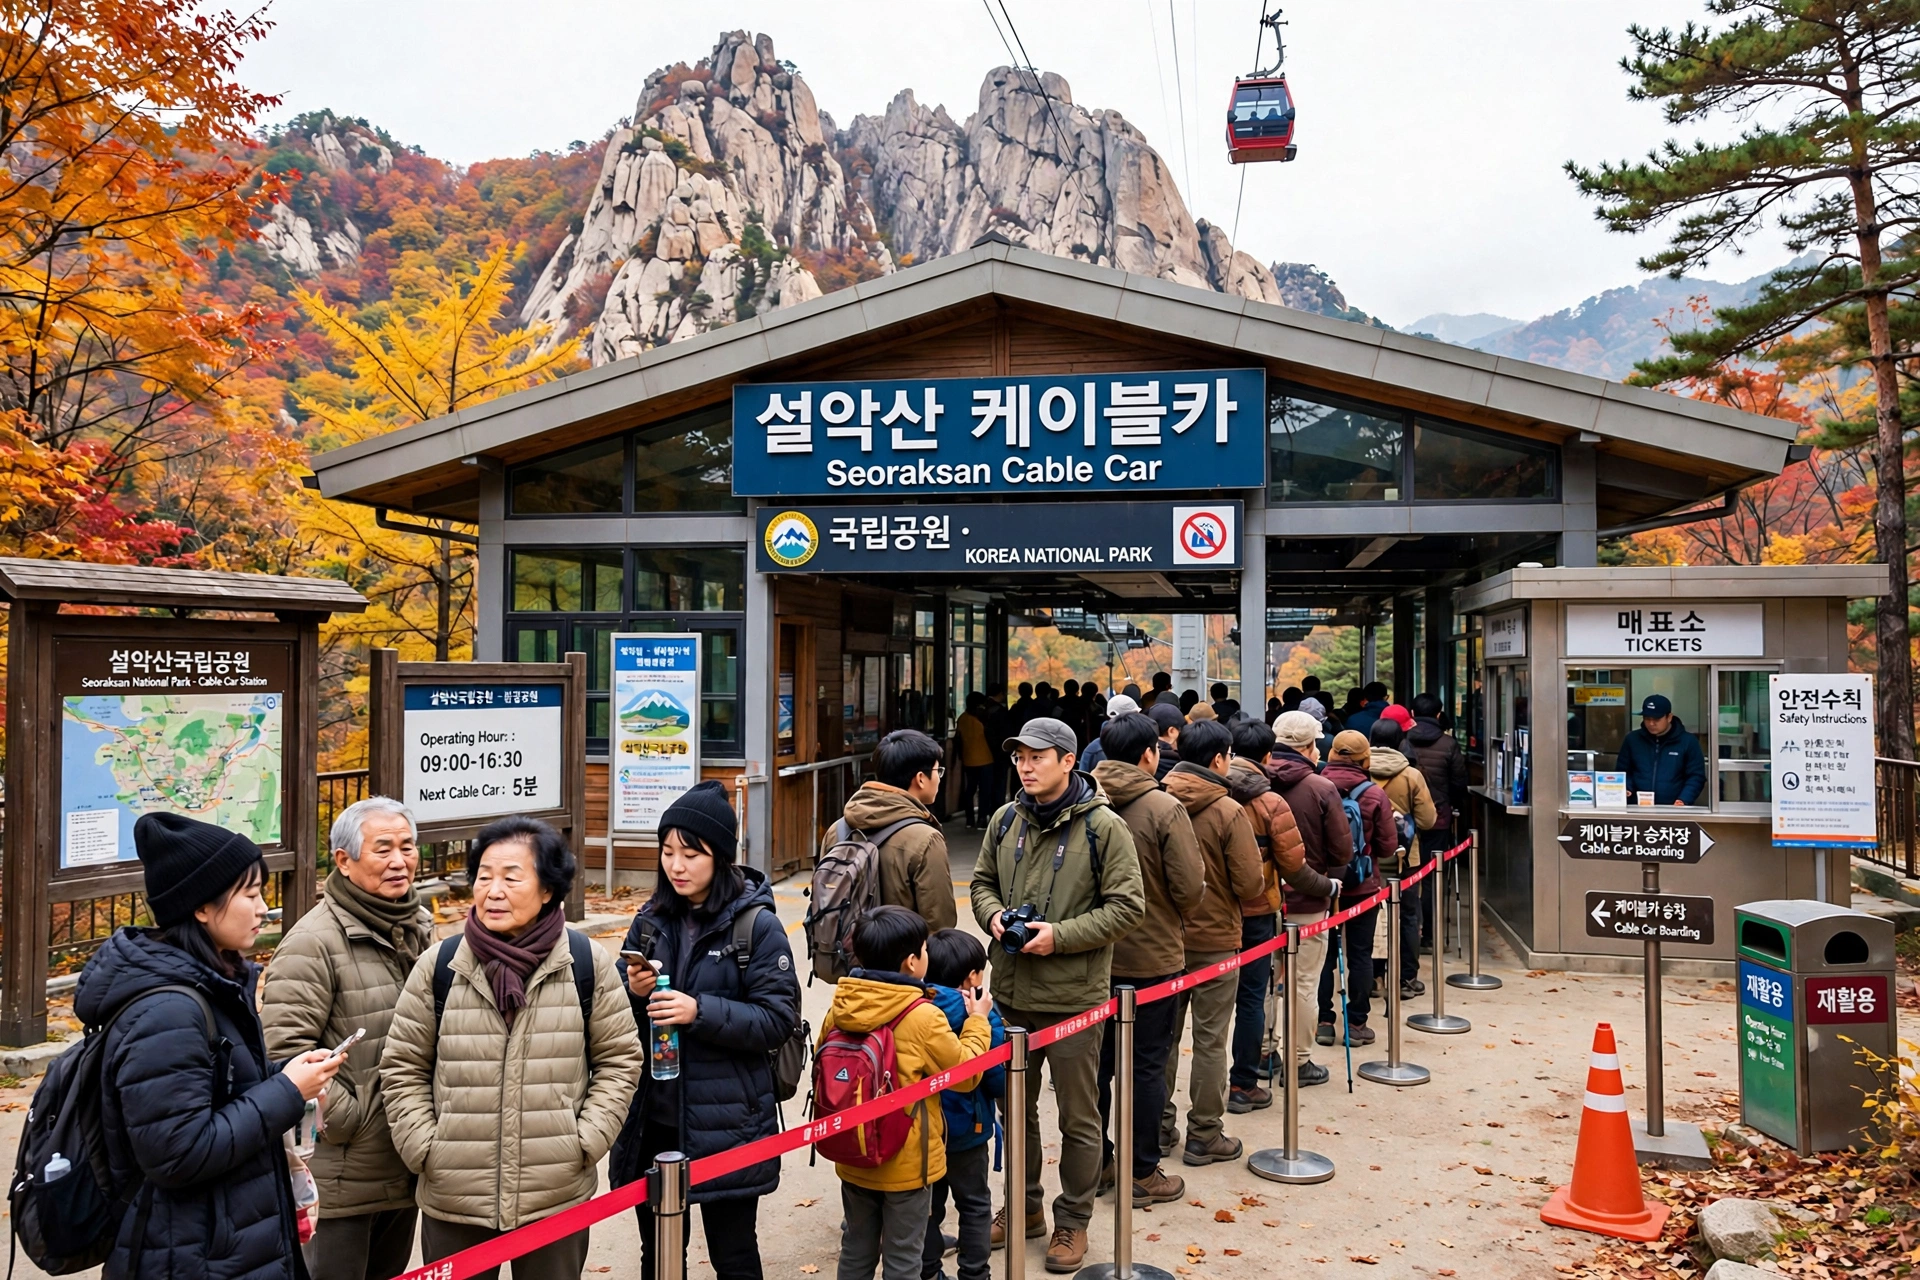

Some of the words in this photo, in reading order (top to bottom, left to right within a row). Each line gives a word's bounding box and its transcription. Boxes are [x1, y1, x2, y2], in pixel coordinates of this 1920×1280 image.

[755, 387, 945, 454] 설악산
[970, 376, 1238, 448] 케이블카
[826, 458, 991, 486] Seoraksan
[1001, 455, 1094, 484] Cable
[1104, 454, 1163, 482] Car
[829, 514, 951, 551] 국립공원
[965, 547, 1021, 564] KOREA
[1024, 547, 1105, 564] NATIONAL
[1109, 546, 1153, 563] PARK
[1617, 608, 1706, 635] 매표소
[1624, 637, 1702, 652] TICKETS
[108, 649, 250, 675] 설악산국립공원
[81, 676, 130, 687] Seoraksan
[1778, 688, 1862, 711] 안전수칙
[1779, 713, 1810, 727] Safety
[1811, 712, 1868, 725] Instructions
[420, 731, 475, 748] Operating
[420, 750, 523, 773] 09:00-16:30
[419, 788, 446, 801] Next
[448, 784, 479, 799] Cable
[513, 775, 538, 797] 5분
[1579, 824, 1641, 845] 케이블카
[1643, 825, 1692, 848] 승차장
[1580, 839, 1611, 855] Cable
[1613, 843, 1634, 855] Car
[1635, 844, 1685, 860] Boarding
[1615, 899, 1660, 918] 케이블카
[1659, 924, 1701, 941] Boarding
[1746, 974, 1784, 1008] 재활용
[1817, 986, 1877, 1014] 재활용
